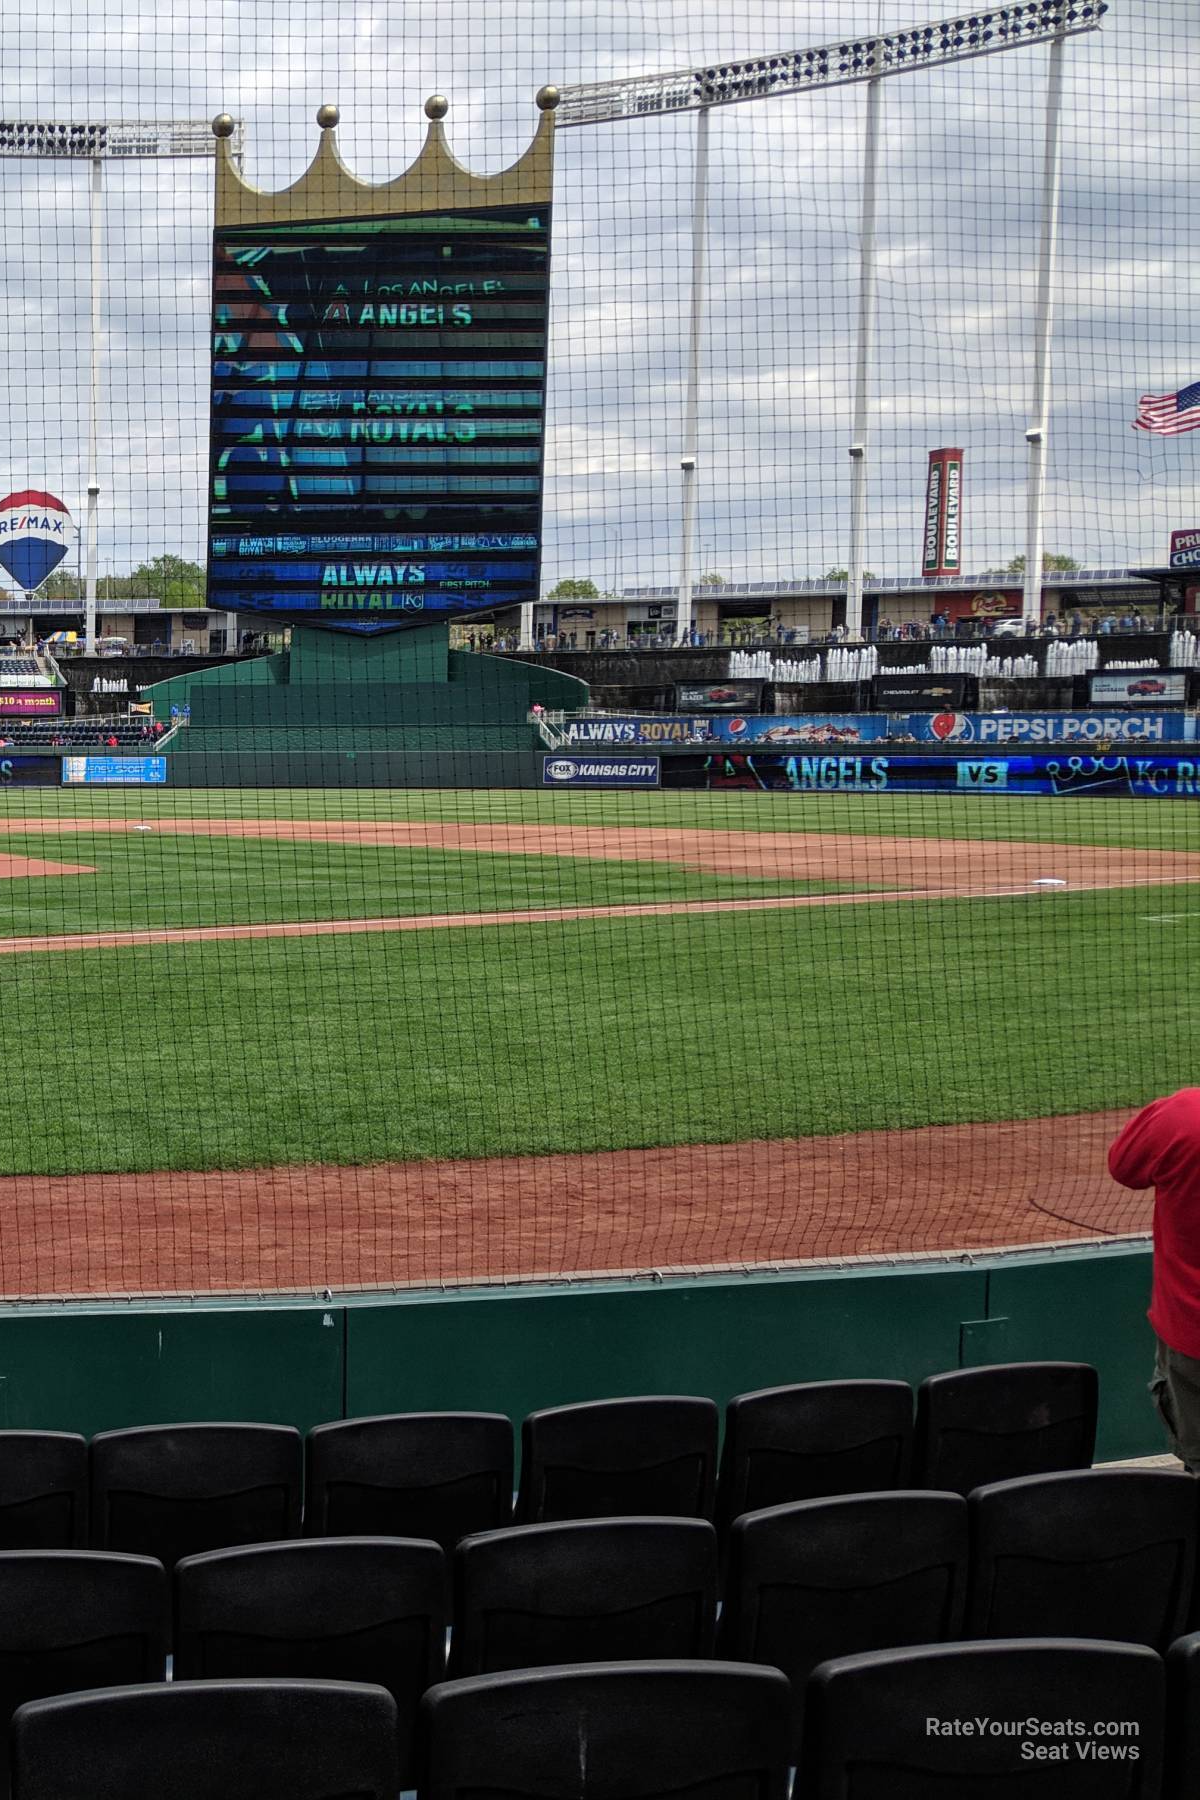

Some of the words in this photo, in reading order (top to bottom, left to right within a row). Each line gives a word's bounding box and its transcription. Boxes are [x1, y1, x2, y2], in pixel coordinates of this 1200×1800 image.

[927, 469, 940, 560] BOULEVARD
[945, 469, 959, 560] BOULEVARD
[321, 565, 425, 586] ALWAYS
[321, 593, 398, 609] ROYAL
[24, 696, 56, 706] month
[568, 722, 635, 740] ALWAYS
[980, 718, 1054, 740] PEPSI
[1062, 717, 1164, 740] PORCH
[554, 765, 571, 773] FOX
[579, 764, 627, 777] KANSAS
[628, 763, 657, 776] CITY
[785, 757, 889, 789] ANGELS
[968, 765, 999, 783] VS
[1135, 761, 1169, 793] KC
